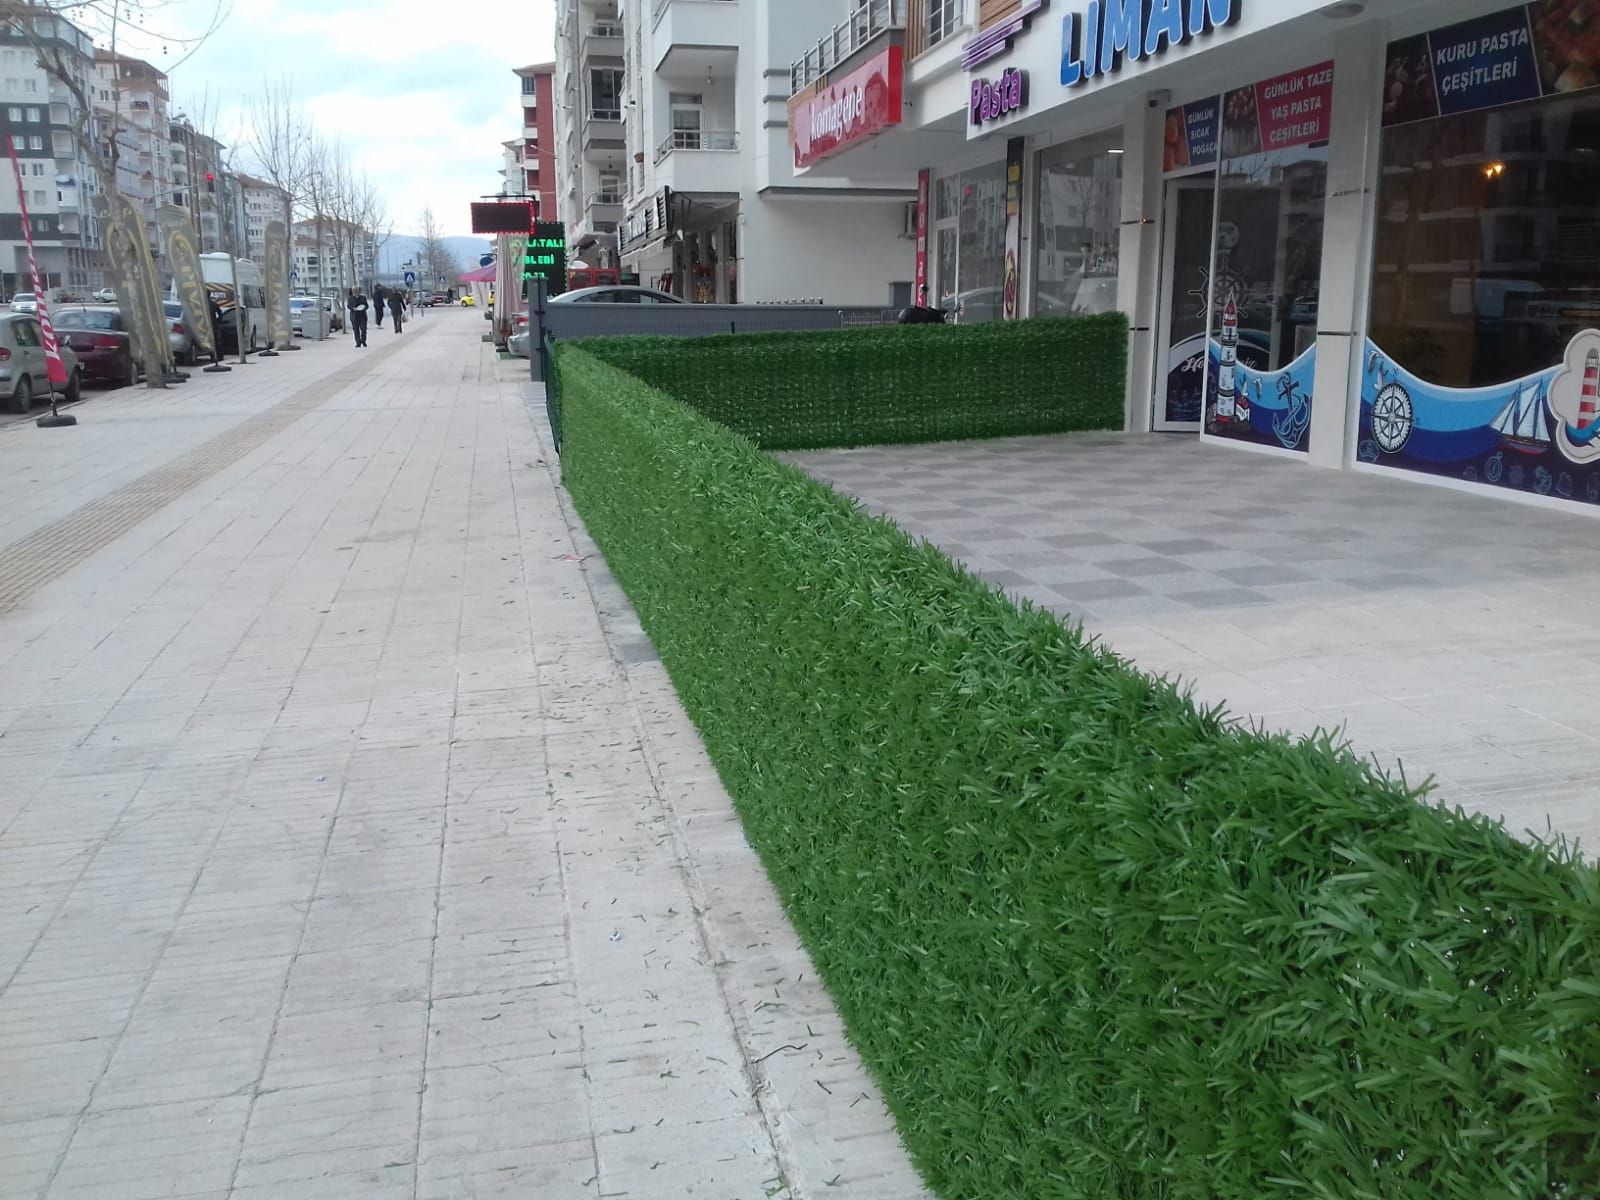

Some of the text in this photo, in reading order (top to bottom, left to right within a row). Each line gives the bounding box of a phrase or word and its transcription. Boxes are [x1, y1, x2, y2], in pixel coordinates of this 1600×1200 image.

[1436, 27, 1528, 65] KURU PASTA
[1307, 69, 1333, 88] TAZE
[1442, 56, 1518, 96] ÇEŞİTLERİ
[970, 67, 1022, 125] Pasta
[1271, 96, 1322, 120] YAŞ PASTA
[811, 87, 863, 141] komagene
[1190, 126, 1210, 140] SICAK
[1270, 117, 1320, 144] ÇEŞİTLERİ
